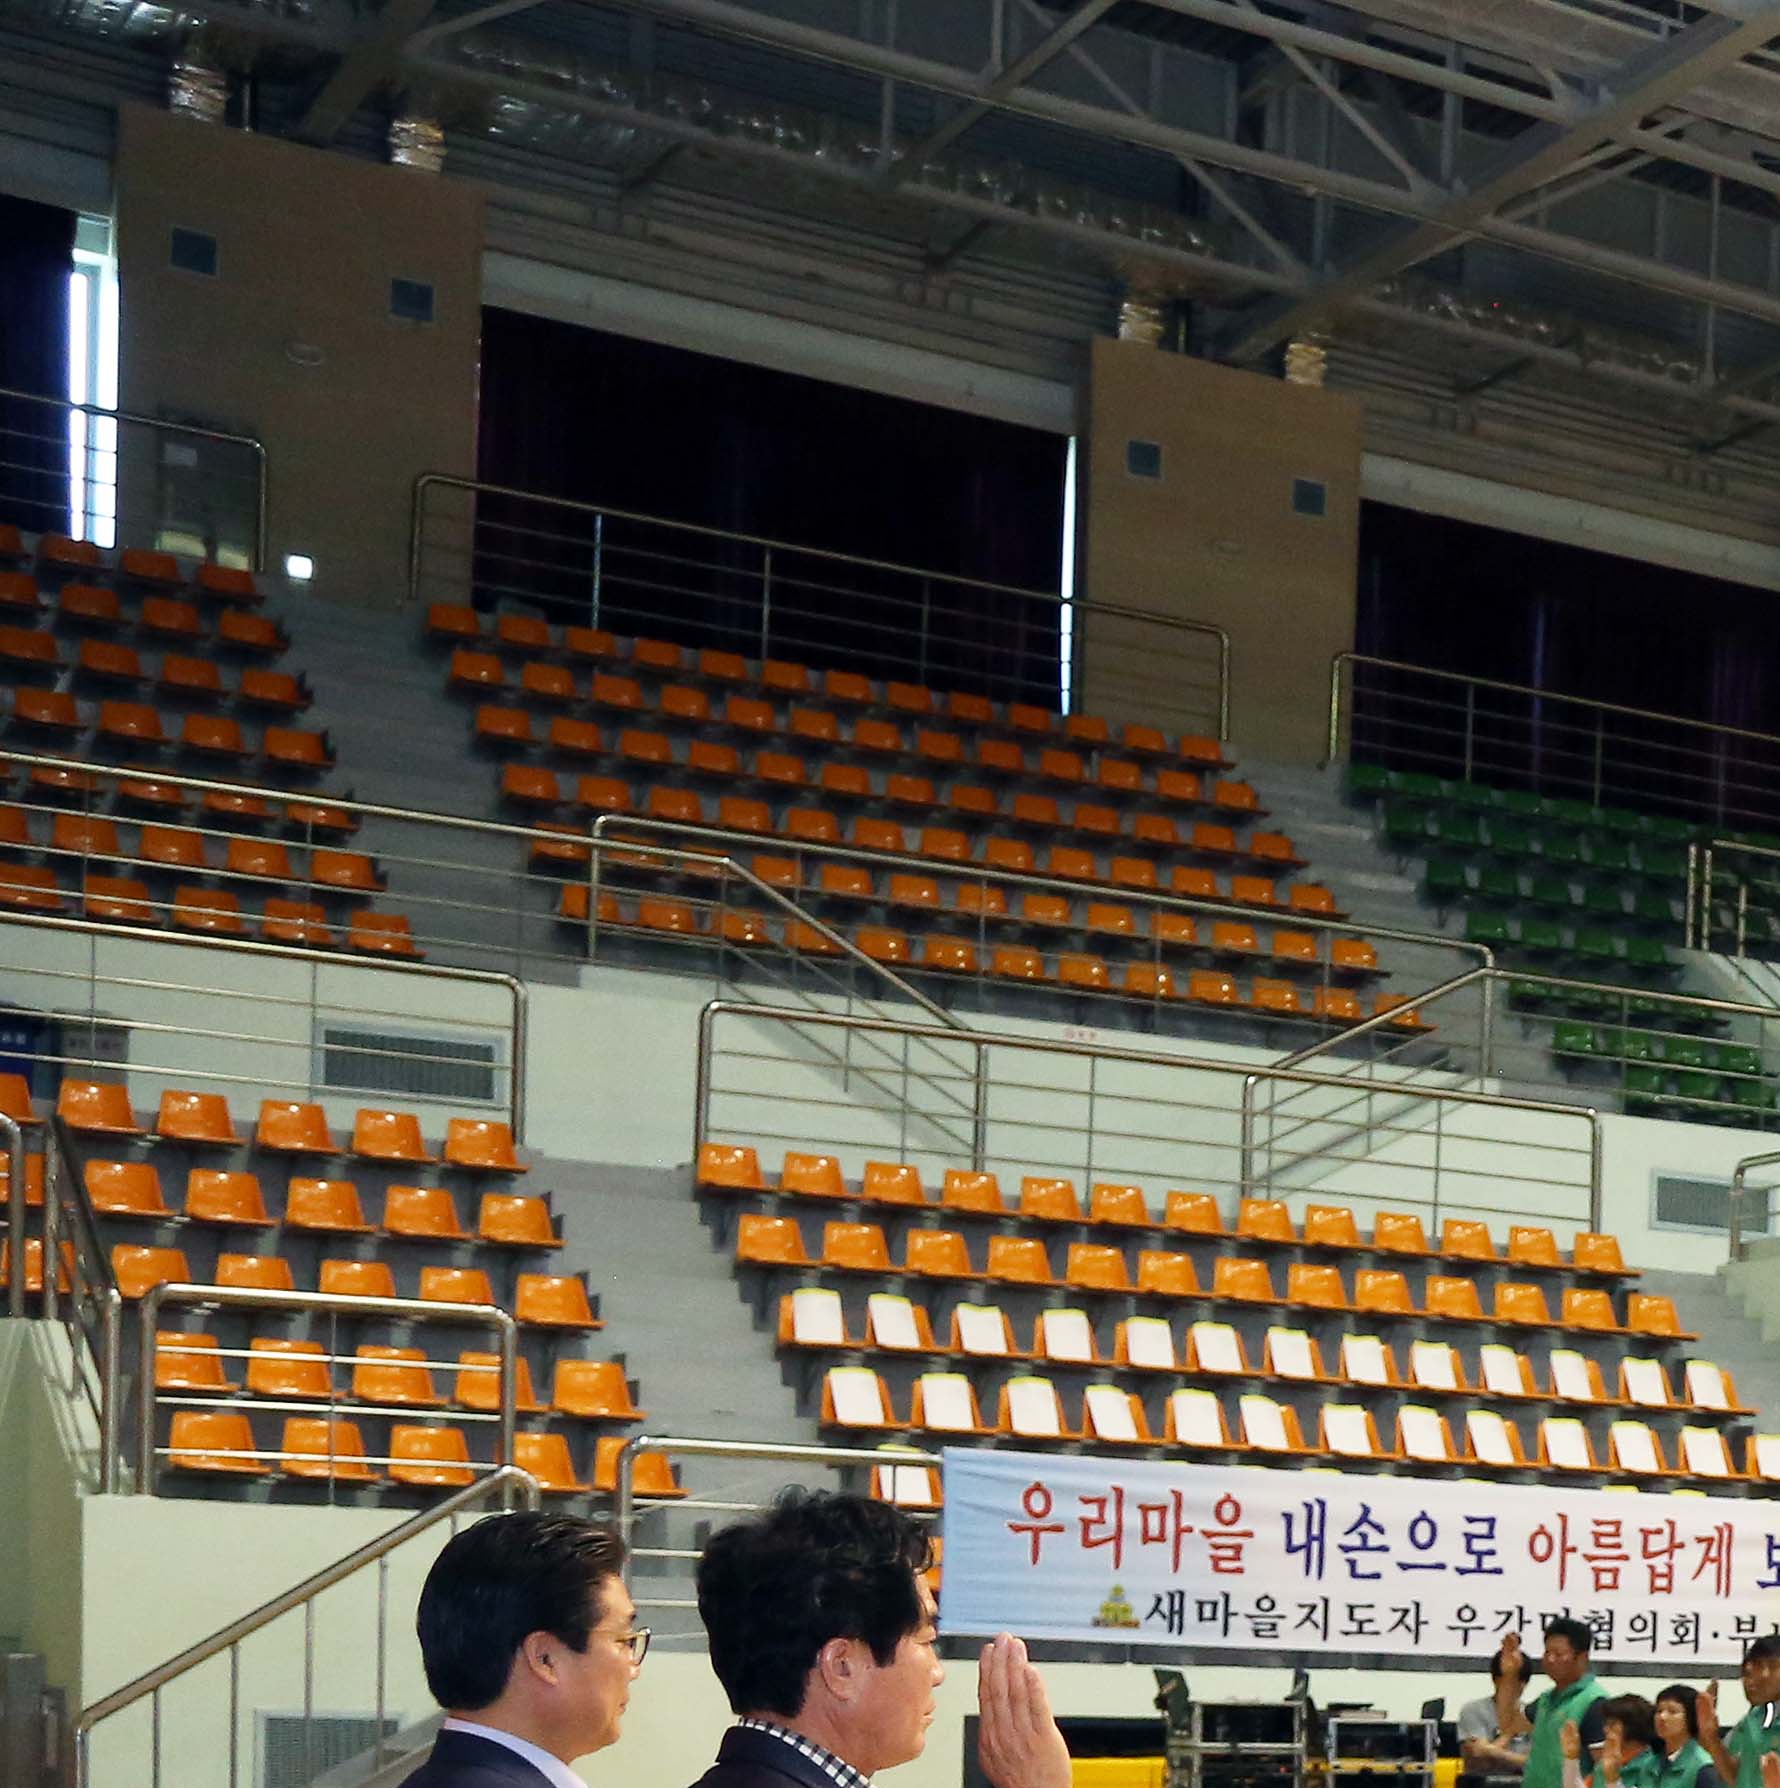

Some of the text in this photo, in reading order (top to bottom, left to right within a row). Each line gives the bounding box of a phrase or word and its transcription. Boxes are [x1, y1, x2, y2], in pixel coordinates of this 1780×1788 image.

[1006, 1479, 1257, 1578] 우리마을
[1284, 1500, 1505, 1582] 내손으로
[1527, 1512, 1737, 1598] 아름답게
[1144, 1590, 1428, 1648] 새마을지도자
